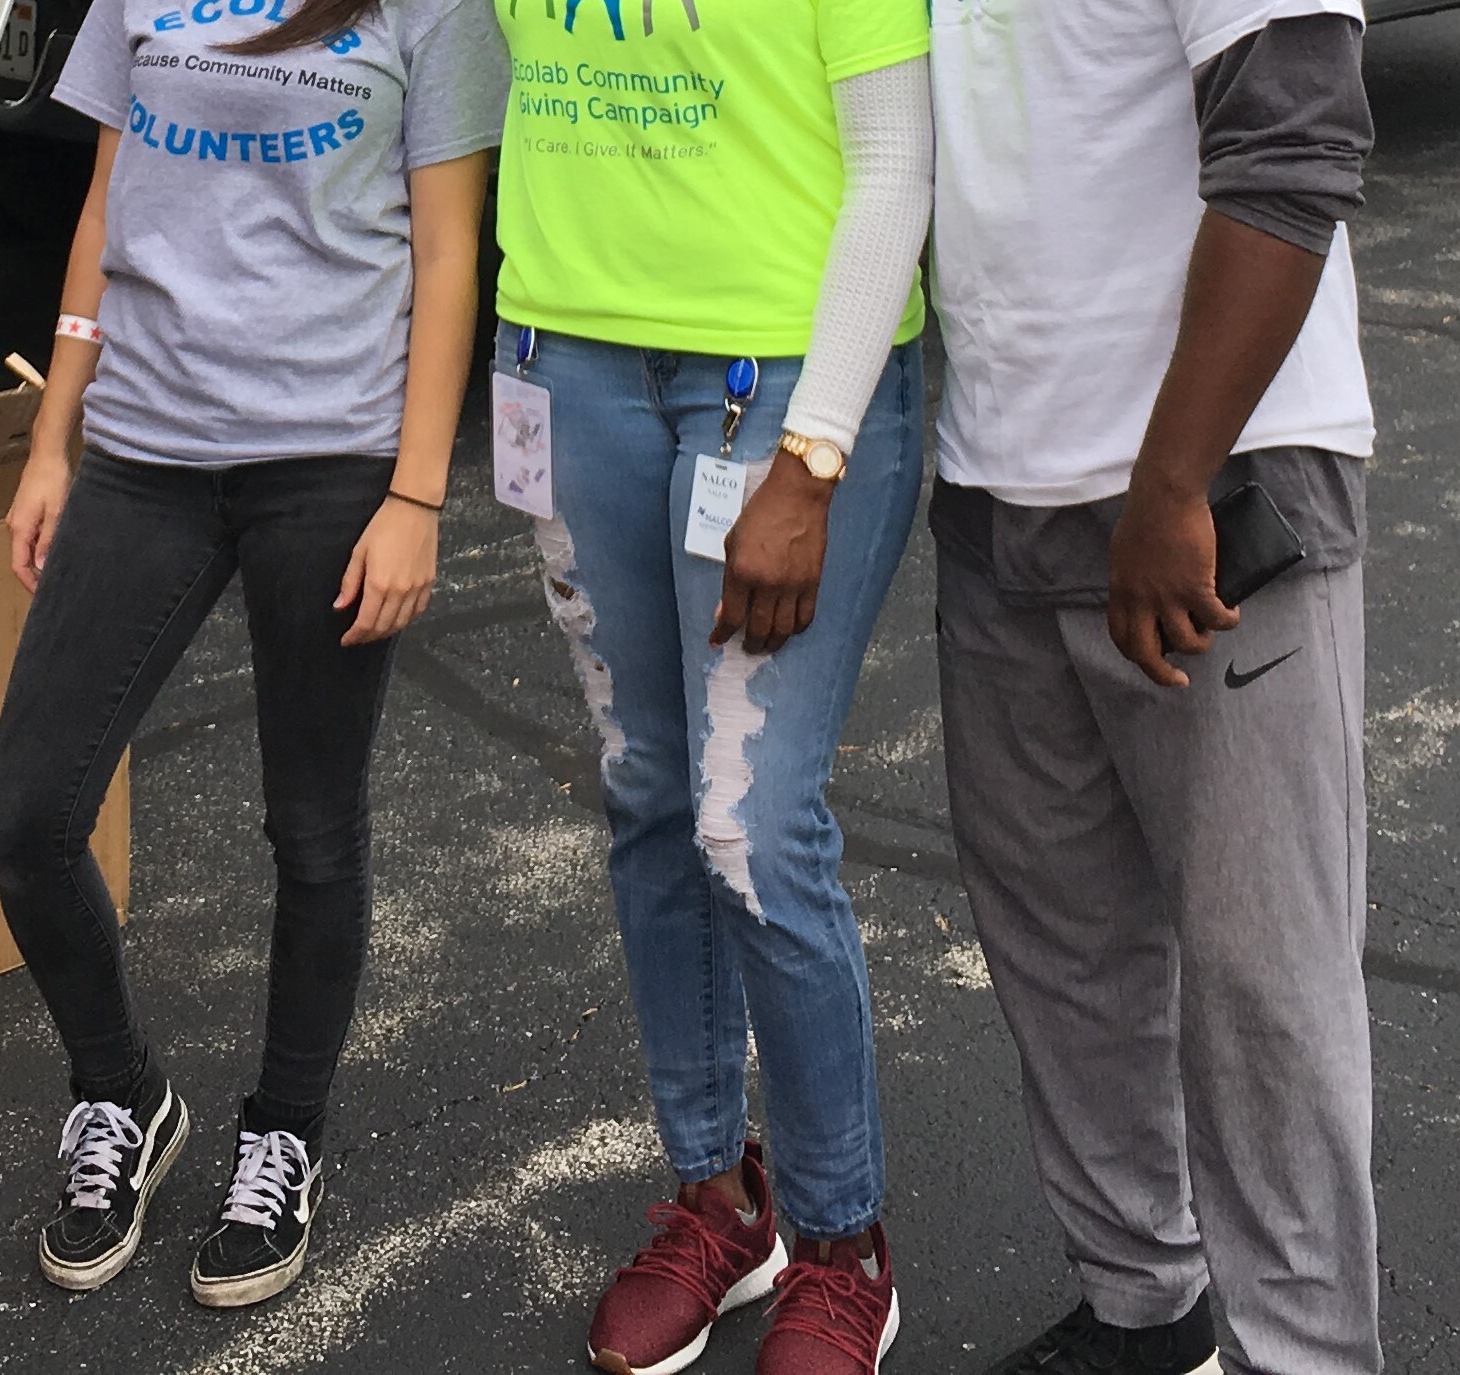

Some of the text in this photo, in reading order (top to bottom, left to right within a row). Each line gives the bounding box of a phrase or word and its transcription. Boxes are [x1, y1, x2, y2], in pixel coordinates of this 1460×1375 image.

[185, 53, 292, 87] Community
[297, 69, 372, 101] Matters
[513, 58, 725, 101] Ecolab Community
[129, 93, 366, 164] OLUNTEERS
[519, 91, 718, 130] Giving Campaign
[536, 138, 572, 155] Care.
[583, 141, 620, 158] Give.
[626, 143, 636, 159] It
[701, 471, 737, 489] NALCO
